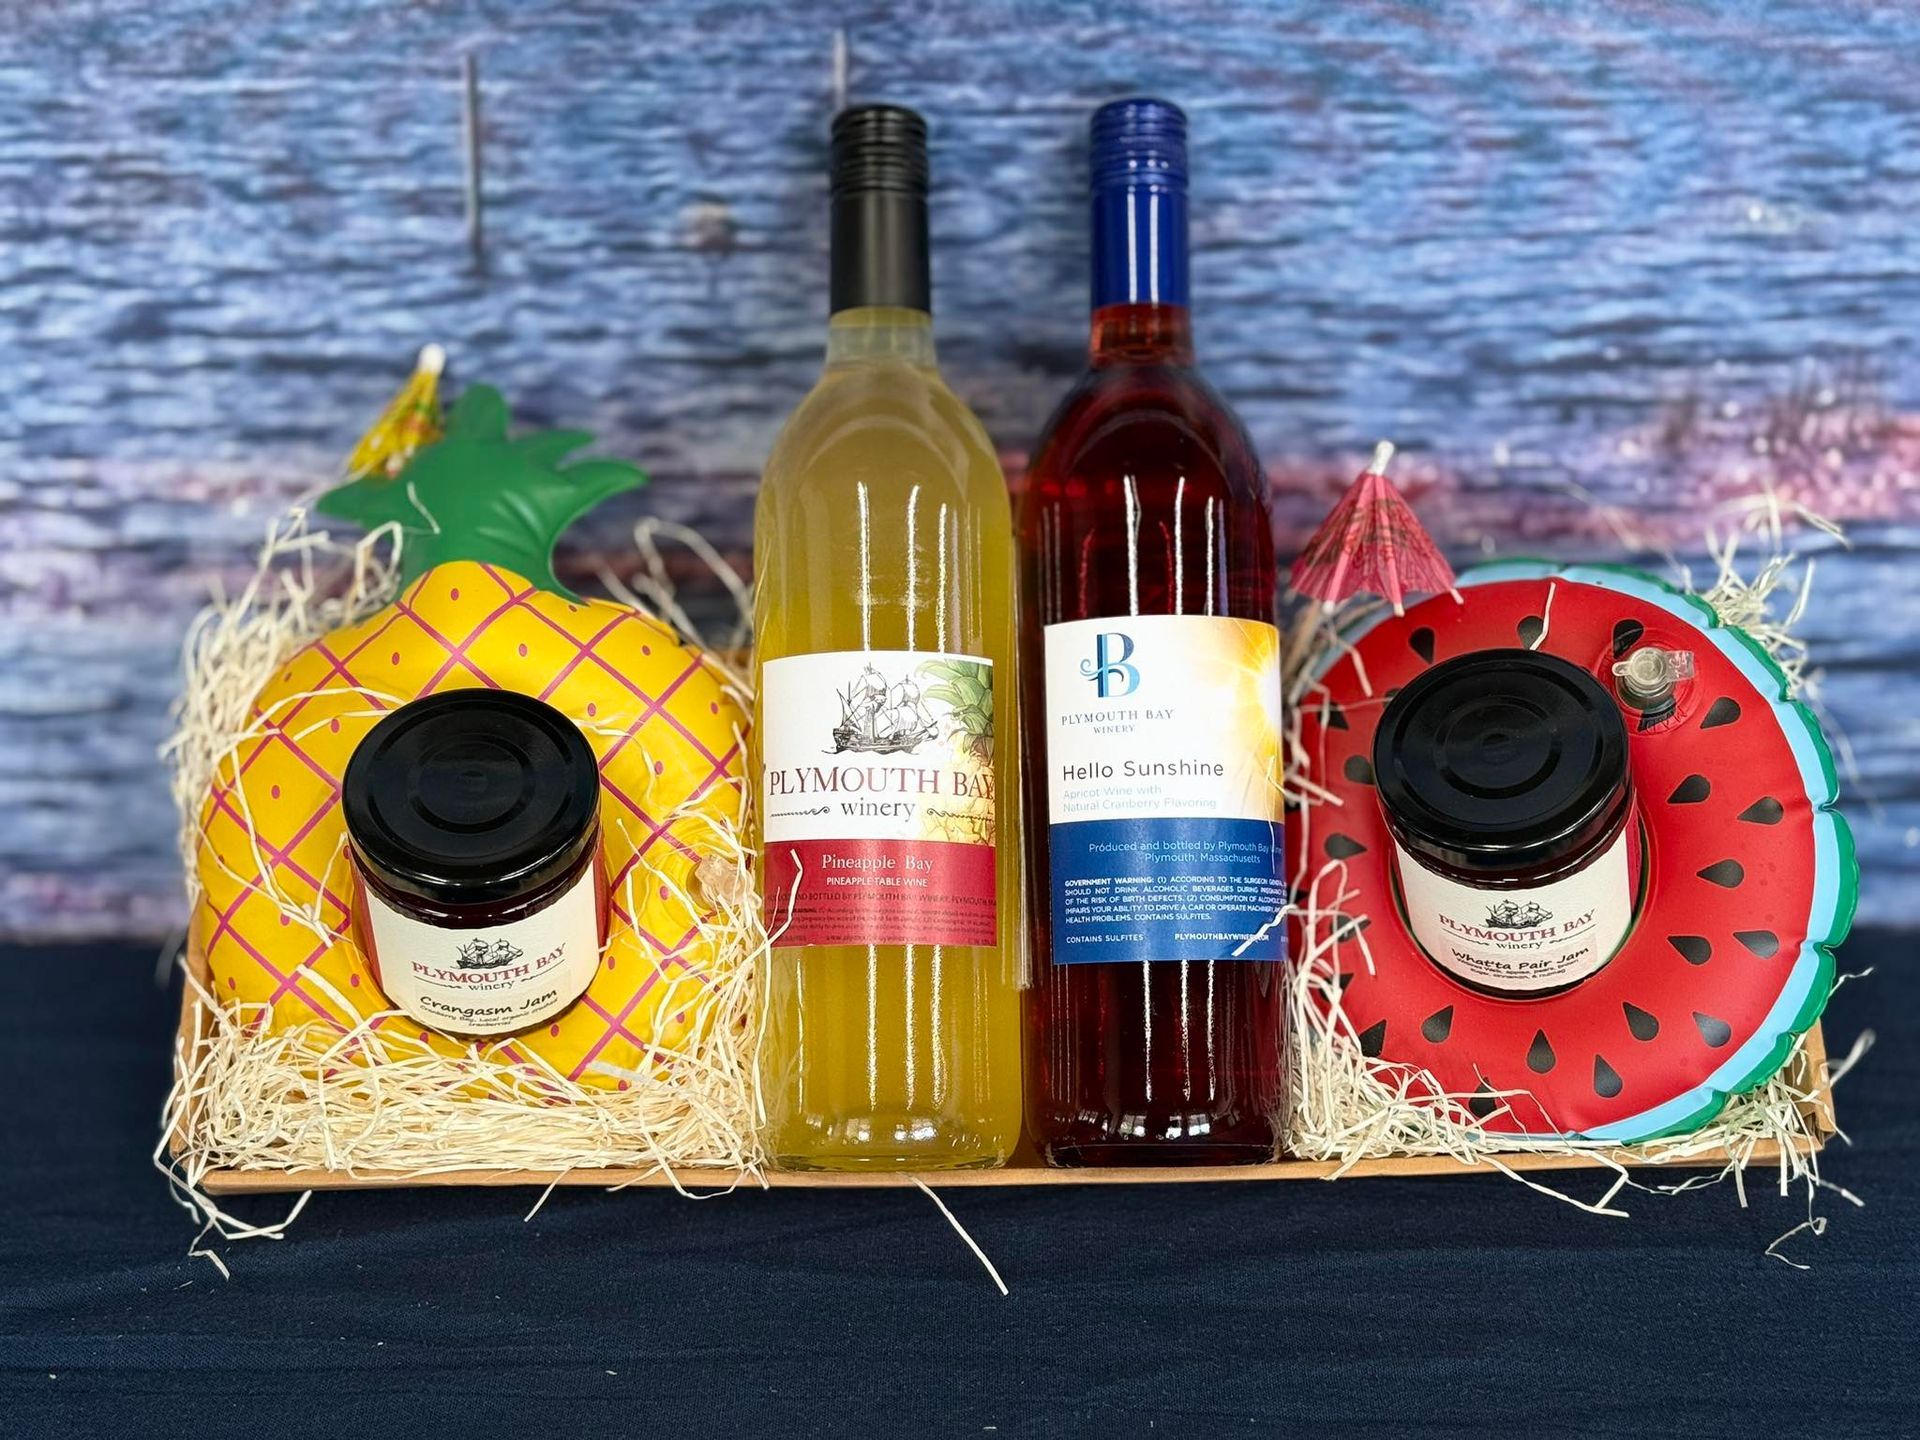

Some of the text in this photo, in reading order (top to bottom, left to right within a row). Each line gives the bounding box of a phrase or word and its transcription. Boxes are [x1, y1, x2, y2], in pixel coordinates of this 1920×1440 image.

[1061, 708, 1175, 726] PLYMOUTH BAY
[1093, 724, 1136, 734] WINERY
[1063, 759, 1225, 781] Hello Sunshine
[769, 766, 995, 800] PLYMOUTH BAY
[1063, 784, 1163, 801] Apricot Wine with
[841, 797, 917, 823] winery
[1063, 797, 1218, 813] Natural Cranberry Flavoring
[1088, 842, 1137, 853] Produced
[1140, 841, 1160, 850] and
[1163, 841, 1201, 851] bottled
[1203, 841, 1216, 852] by
[1218, 841, 1257, 853] Plymouth
[1257, 843, 1269, 854] Bay
[821, 854, 933, 874] Pineapple Bay
[1144, 853, 1261, 864] Plymouth, Massachusetts
[826, 876, 929, 888] PINEAPPLE TABLE WINE
[1064, 877, 1112, 887] GOVERNMENT
[1114, 876, 1155, 885] WARNING:
[1157, 876, 1168, 884] (1)
[1170, 876, 1215, 884] ACCORDING
[1217, 876, 1228, 884] TO
[1230, 877, 1242, 885] THE
[1064, 887, 1091, 897] SHOULD
[1095, 886, 1110, 896] NOT
[1114, 886, 1139, 894] DRINK
[1143, 885, 1188, 893] ALCOHOLIC
[1192, 885, 1234, 893] BEVERAGES
[1065, 898, 1074, 906] OF
[1076, 897, 1089, 906] THE
[1090, 896, 1108, 905] RISK
[1109, 896, 1121, 904] OF
[1122, 895, 1146, 904] BIRTH
[1186, 894, 1198, 902] (2)
[1199, 894, 1249, 903] CONSUMPTION
[1091, 905, 1113, 914] YOUR
[1113, 904, 1143, 913] ABILITY
[1143, 904, 1155, 912] TO
[1155, 903, 1180, 912] DRIVE
[1180, 903, 1188, 911] A
[1188, 903, 1205, 911] CAR
[1205, 903, 1217, 911] OR
[1217, 904, 1247, 912] OPERATE
[1065, 915, 1091, 924] HEALTH
[1134, 913, 1175, 921] CONTAINS
[1438, 908, 1595, 942] PLYMOUTH BAY
[1066, 934, 1144, 944] CONTAINS SULFITES
[1495, 941, 1543, 950] winery
[411, 943, 566, 984] PLYMOUTH BAY
[1451, 948, 1512, 970] What'ta
[1518, 960, 1552, 970] Pair
[1556, 947, 1590, 964] Jam
[468, 979, 515, 991] winery
[420, 989, 558, 1018] Crangasm Jam
